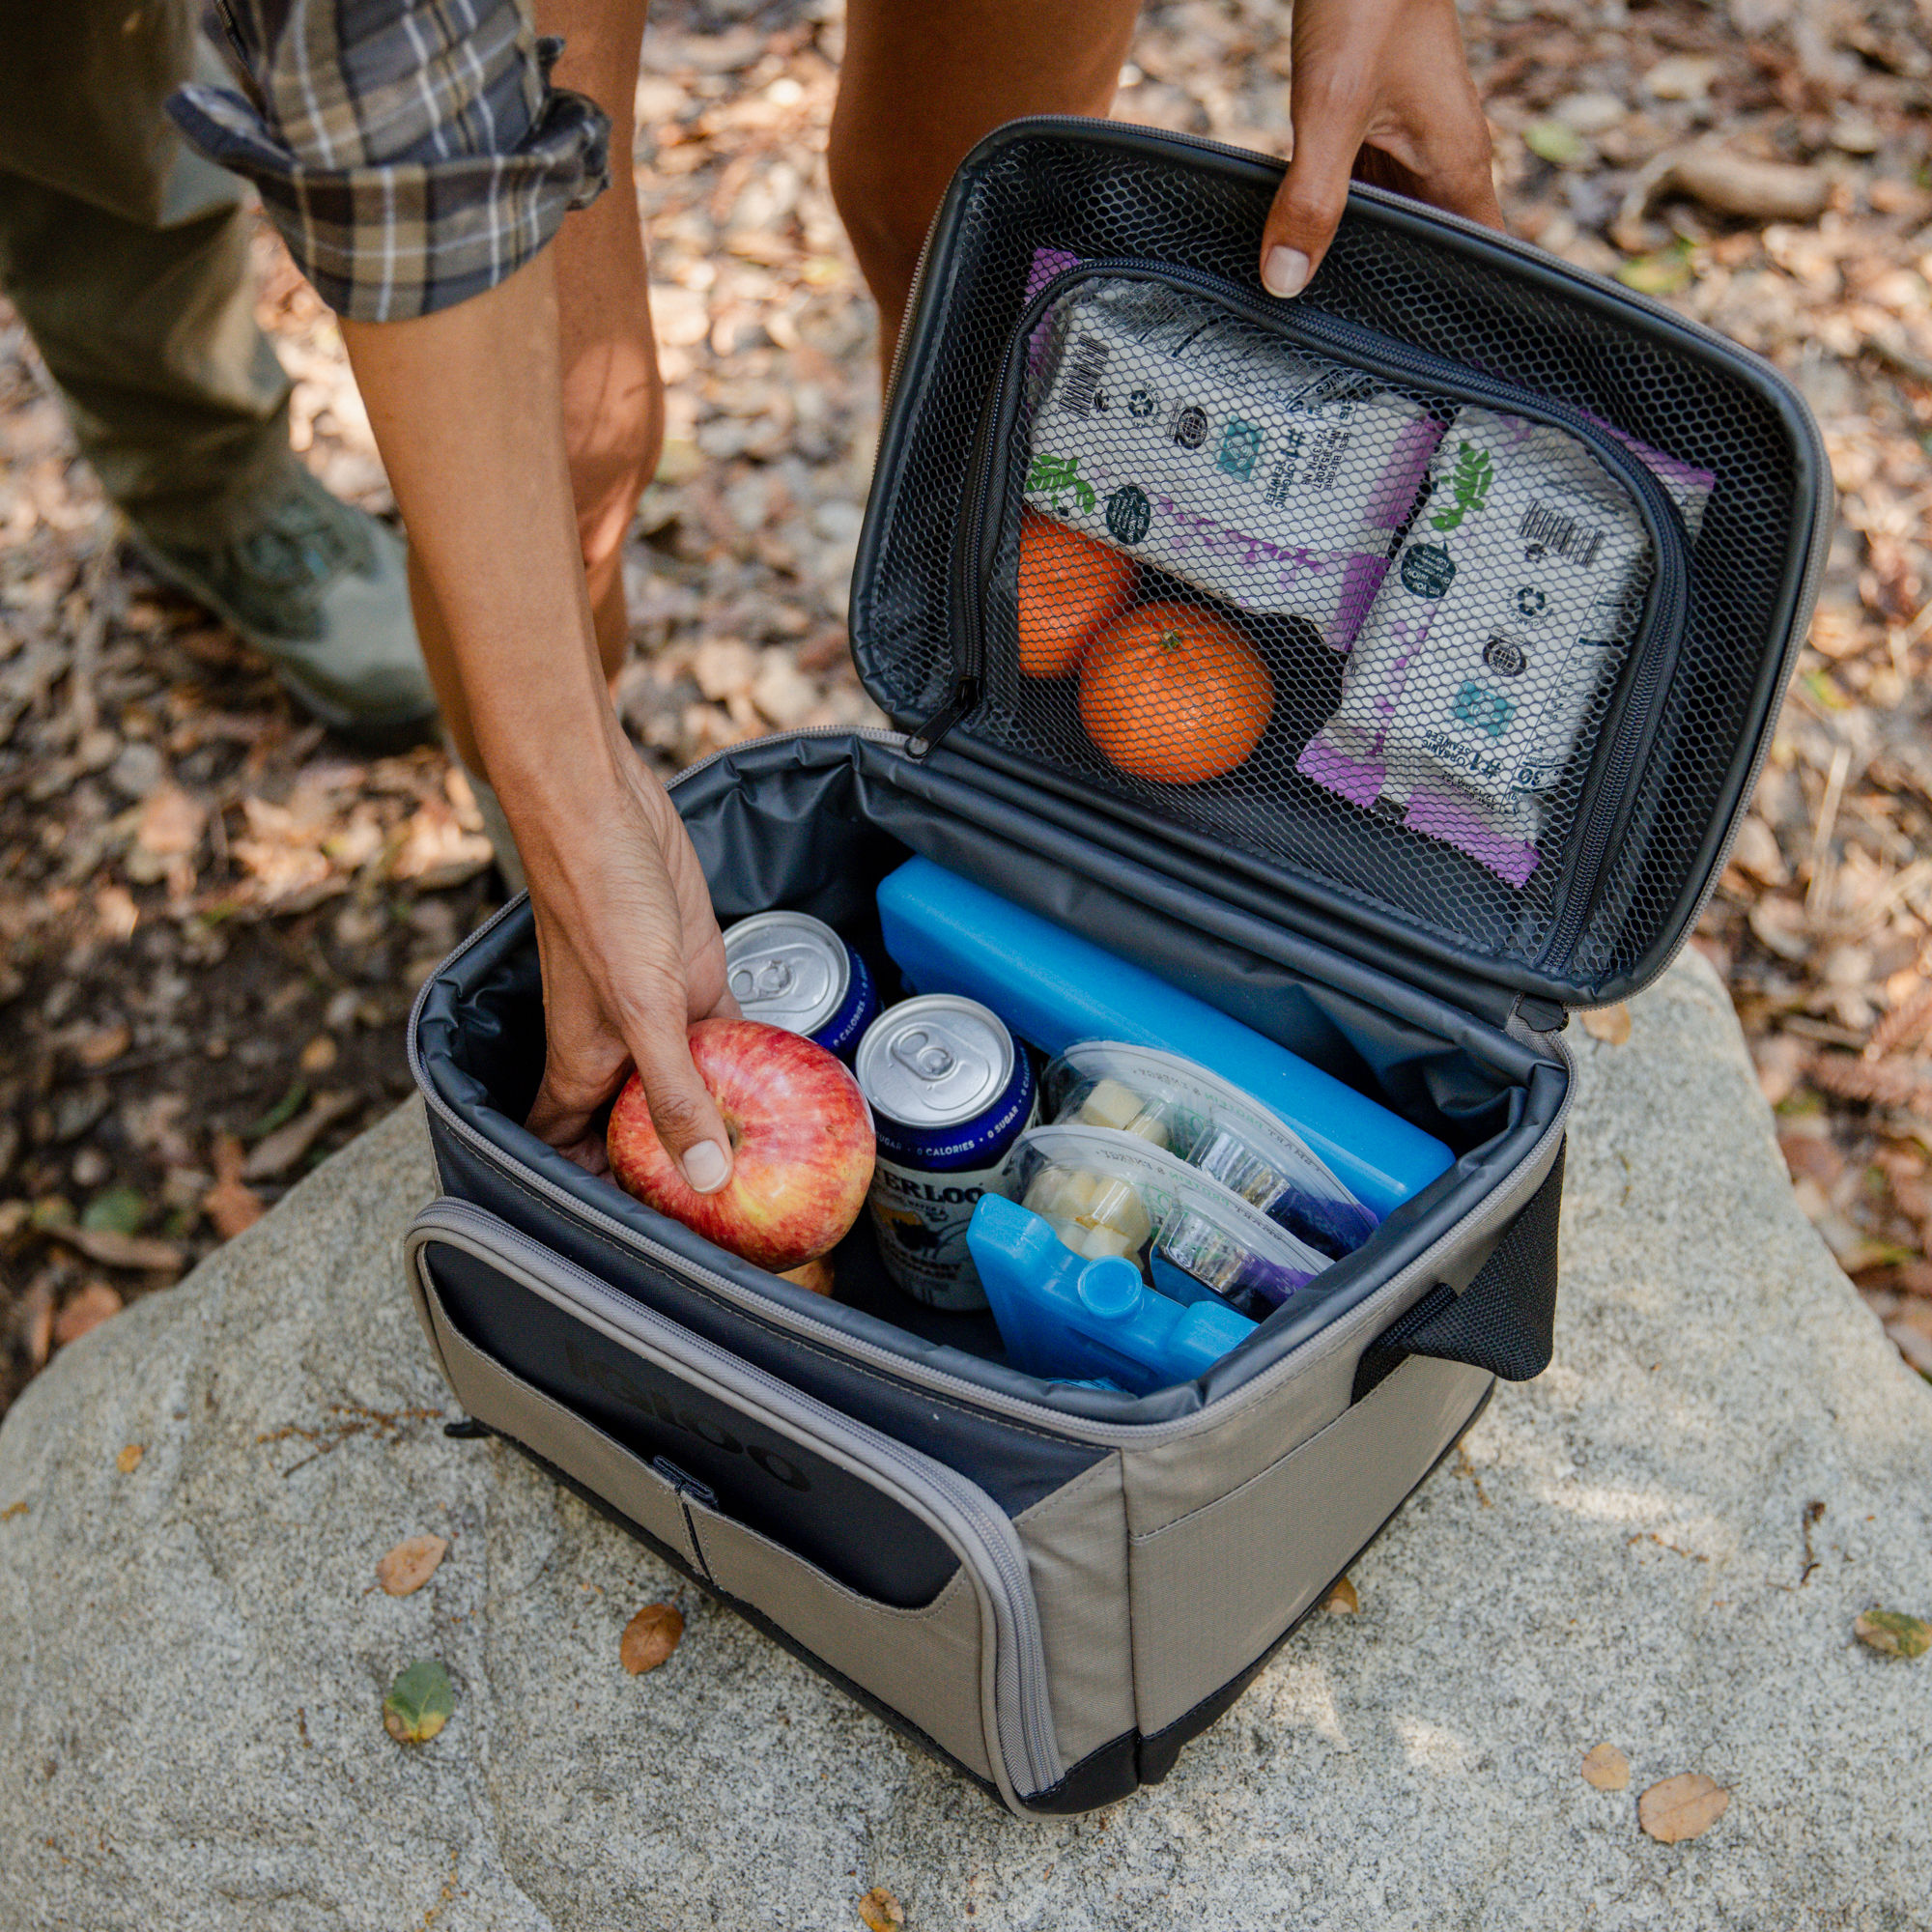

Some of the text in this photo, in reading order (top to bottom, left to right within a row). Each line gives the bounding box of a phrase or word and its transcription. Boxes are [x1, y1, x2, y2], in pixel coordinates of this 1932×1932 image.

[1275, 464, 1295, 509] ORGANIC
[1422, 739, 1465, 766] ORGANIC
[839, 1000, 866, 1041] CALORIES
[925, 1139, 975, 1157] CALORIES
[994, 1105, 1019, 1135] SUGAR
[875, 1166, 984, 1204] ERLOO
